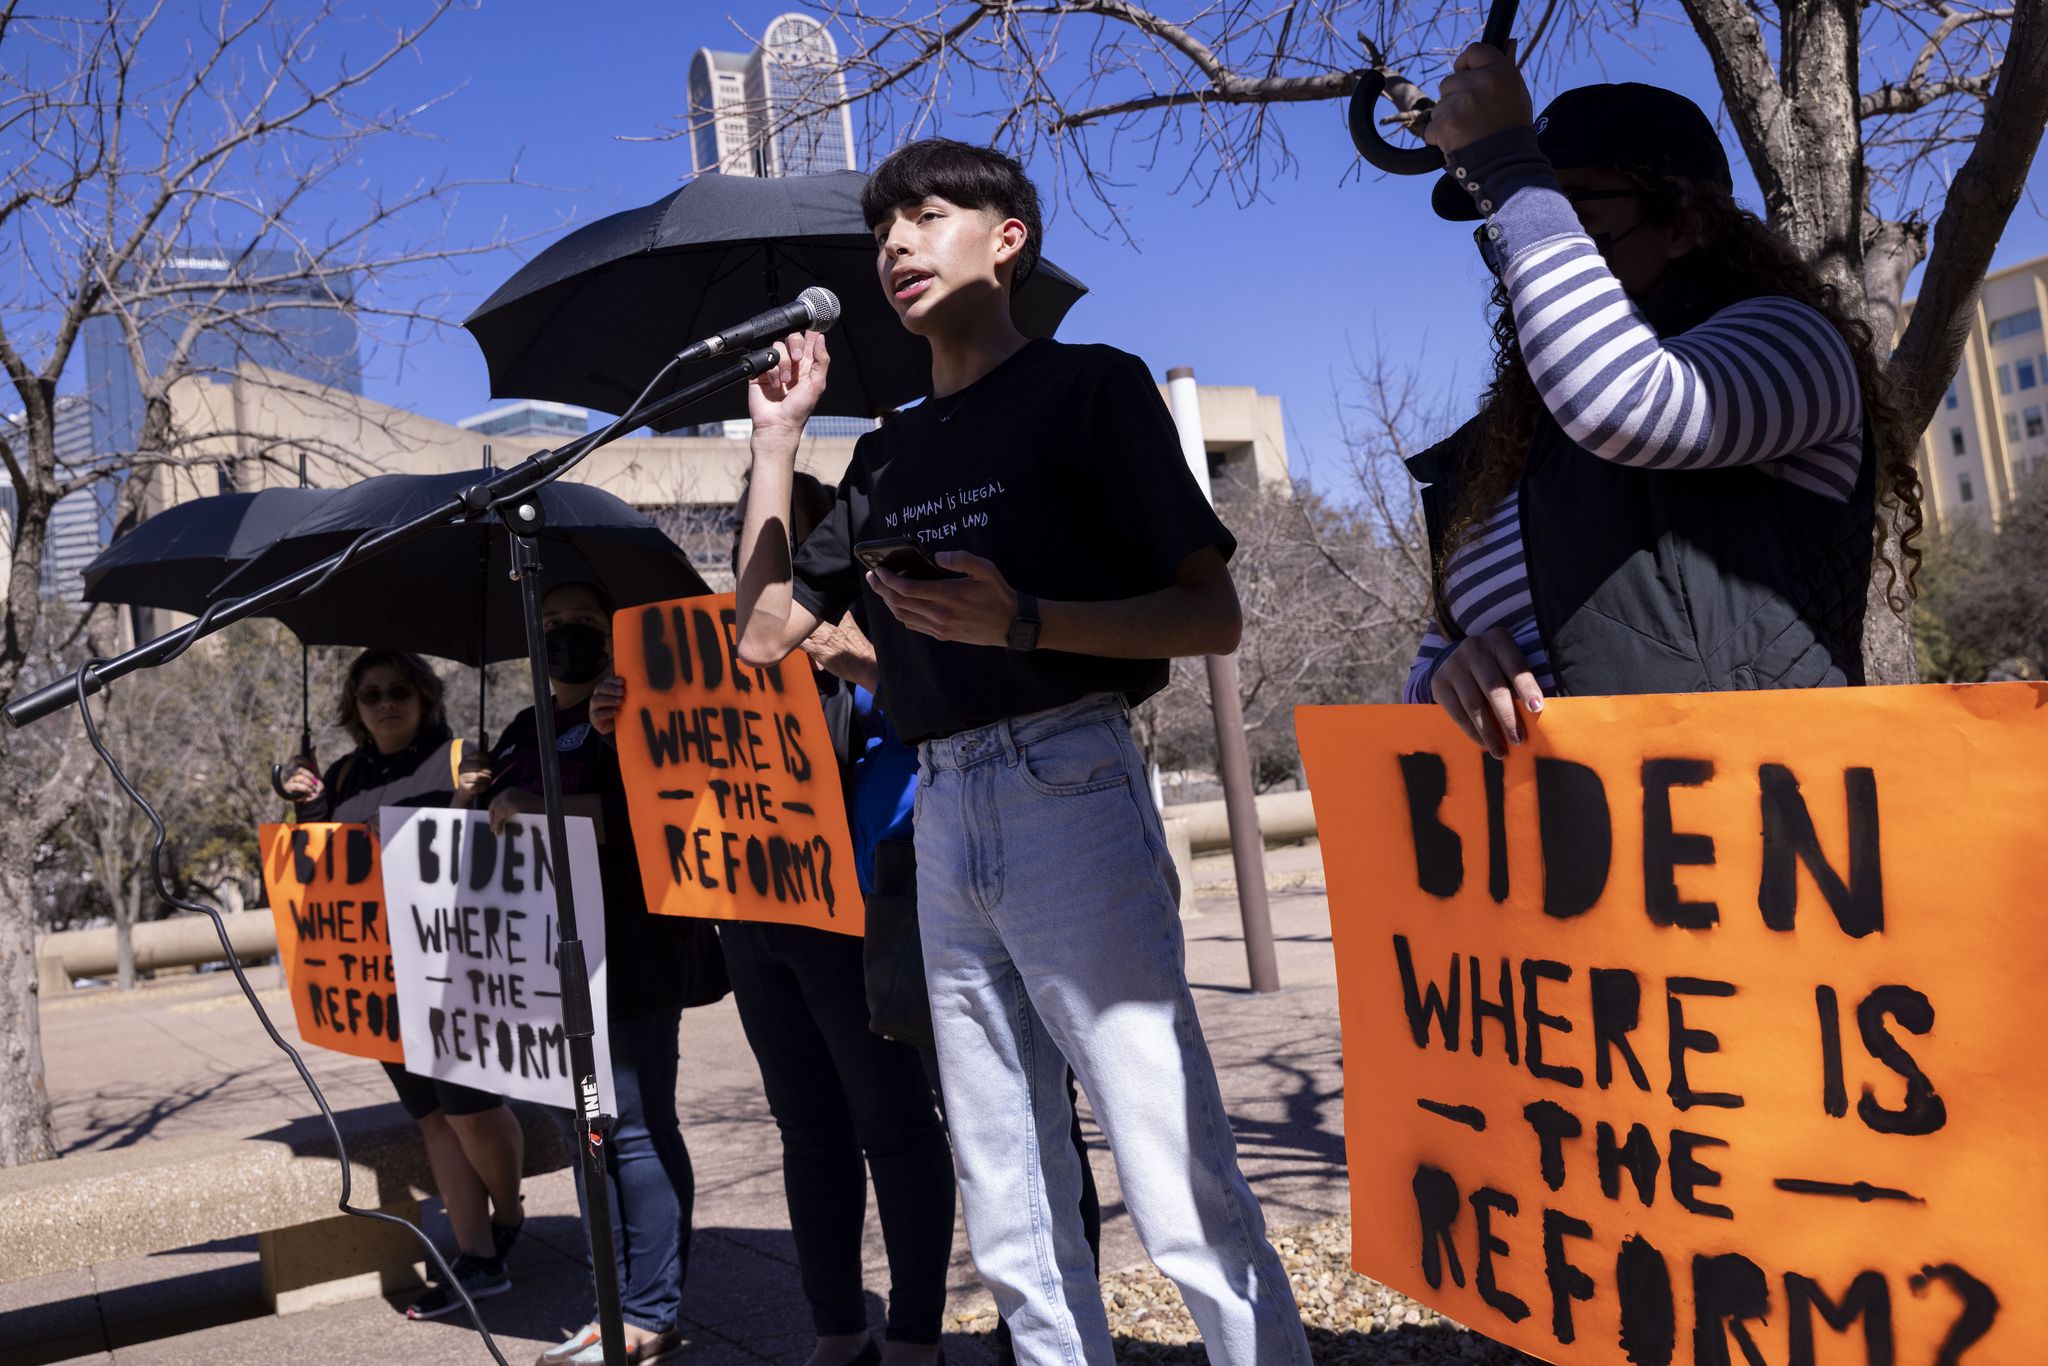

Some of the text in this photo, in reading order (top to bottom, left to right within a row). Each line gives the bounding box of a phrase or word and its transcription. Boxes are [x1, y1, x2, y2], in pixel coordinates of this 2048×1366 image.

[885, 512, 898, 528] NO
[902, 496, 943, 524] HUMAN
[916, 511, 988, 543] STOLEN LAND
[640, 706, 812, 783] WHERE IS
[707, 779, 778, 824] THE
[663, 824, 836, 918] REFORM?
[1397, 751, 1886, 939] BIDEN
[289, 900, 391, 944] WHER
[411, 904, 527, 964] WHERE
[465, 969, 527, 1010] THE
[429, 1006, 568, 1079] REFORM
[1393, 933, 1948, 1136] WHERE IS
[1522, 1098, 1735, 1221] THE
[1411, 1163, 2002, 1366] REFORM?
